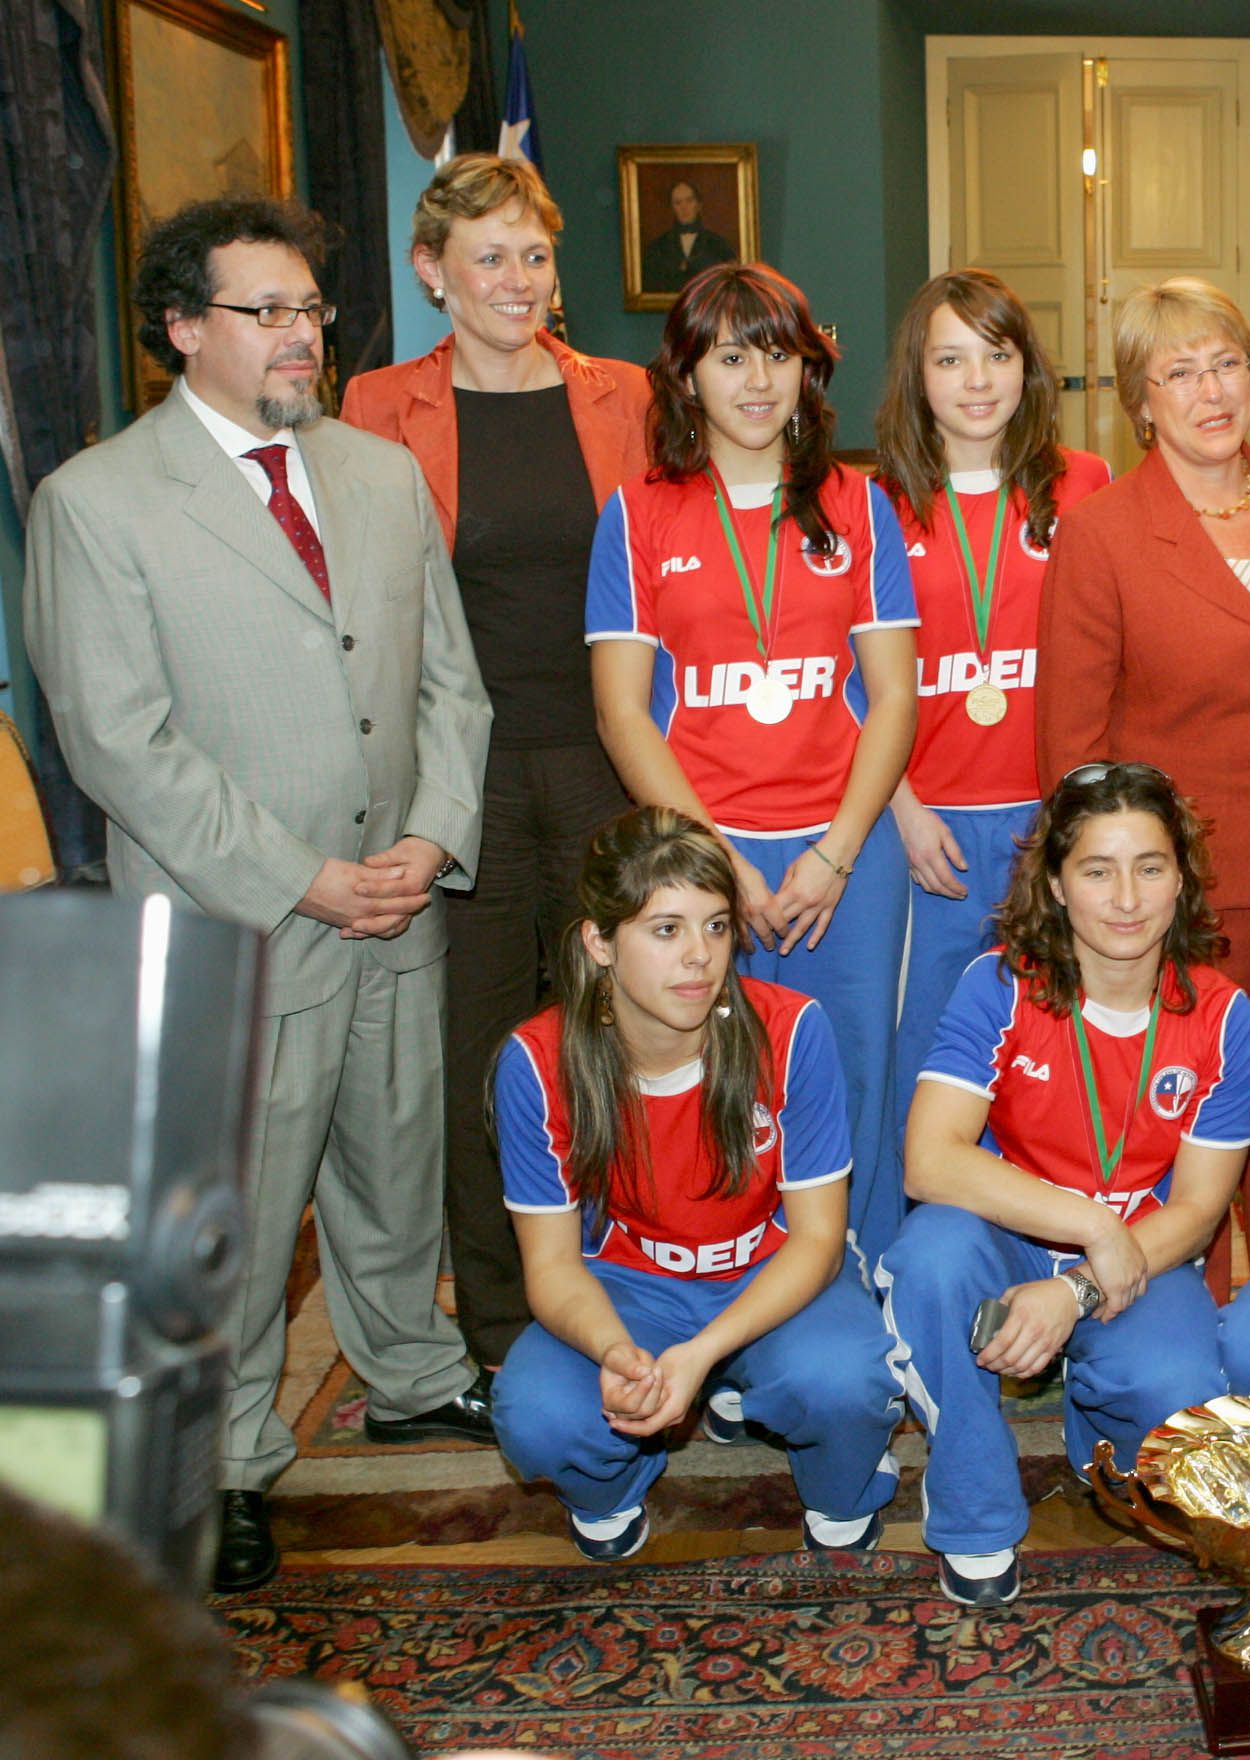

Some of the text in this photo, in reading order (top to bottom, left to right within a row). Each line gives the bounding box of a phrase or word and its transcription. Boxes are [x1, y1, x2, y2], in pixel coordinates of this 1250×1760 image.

[661, 556, 701, 577] FILA
[684, 656, 837, 708] LIDER
[1011, 1055, 1050, 1081] FILA
